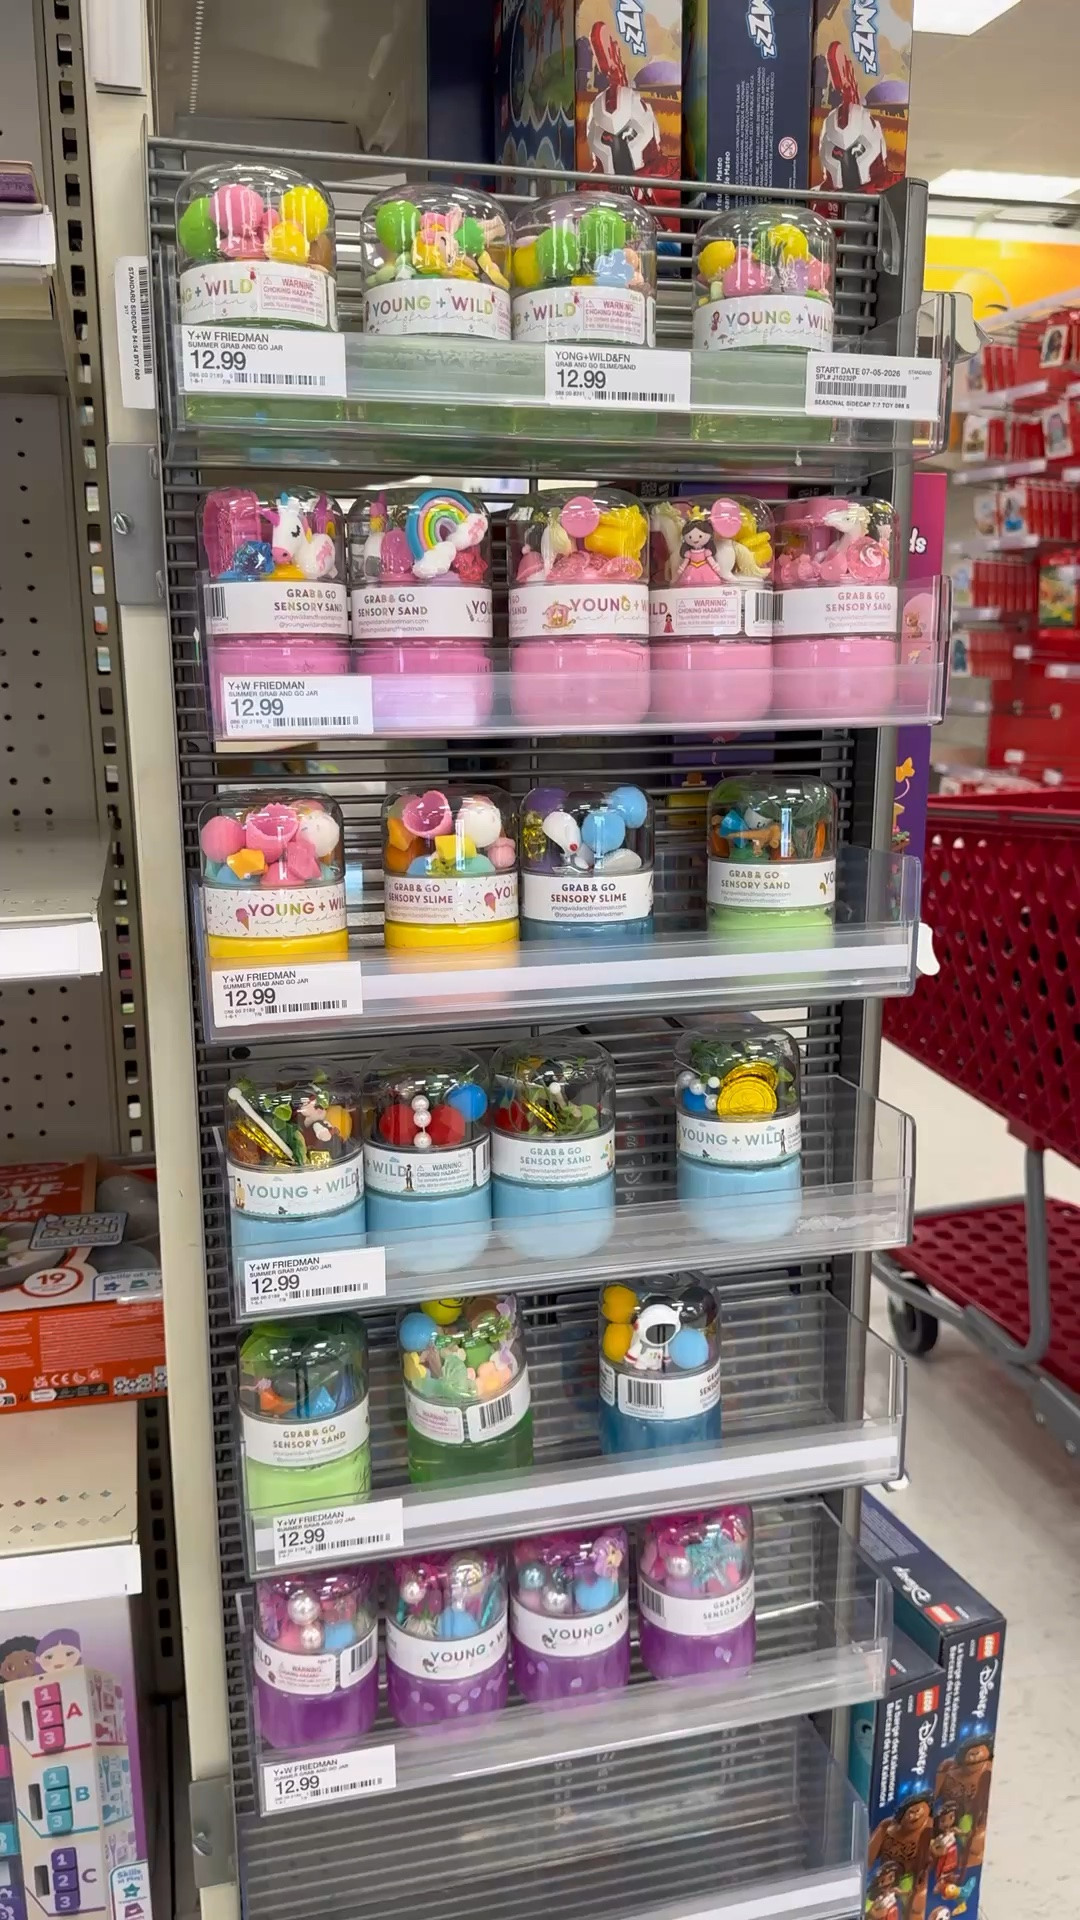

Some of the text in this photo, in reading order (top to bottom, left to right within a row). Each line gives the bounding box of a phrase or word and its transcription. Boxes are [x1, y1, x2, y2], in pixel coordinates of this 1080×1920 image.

[205, 278, 252, 296] WILD
[373, 296, 494, 316] YOUNG WILD
[533, 303, 576, 320] WILD
[726, 310, 791, 328] YOUNG
[188, 331, 268, 342] Y+W FRIEDMAN
[190, 350, 246, 370] 12.99
[556, 352, 630, 363] YONG+WILD&FN
[816, 366, 900, 377] START DATE 07-05-2026
[557, 370, 606, 388] 12.99
[846, 400, 870, 408] SIDECAP
[286, 588, 316, 598] GRAB
[325, 590, 336, 599] GO
[364, 594, 415, 604] GRAB GO
[838, 592, 885, 600] GRAB & GO
[274, 602, 342, 612] SENSORY SAND
[570, 597, 631, 612] YOUNG
[826, 603, 891, 612] SENSORY SAND
[358, 606, 428, 617] SENSORY SAND
[228, 682, 305, 690] Y+W FRIEDMAN
[231, 698, 284, 716] 12.99
[729, 870, 752, 878] GRAB
[764, 871, 780, 879] GO
[394, 883, 440, 892] GRAB & GO
[562, 883, 616, 892] GRAB & GO
[721, 880, 790, 890] SENSORY SAND
[389, 893, 453, 904] SENSORY SLIME
[550, 893, 626, 903] SENSORY SLIME
[248, 902, 314, 916] YOUNG
[223, 970, 296, 983] Y+W FRIEDMAN
[225, 988, 276, 1007] 12.99
[682, 1126, 728, 1145] YOUNG
[745, 1132, 780, 1146] WILD
[530, 1148, 556, 1156] GRAB
[558, 1148, 564, 1156] &
[520, 1156, 590, 1166] SENSORY SAND
[373, 1160, 406, 1178] WILD
[247, 1184, 308, 1199] YOUNG
[326, 1172, 357, 1192] WILD
[249, 1256, 320, 1272] Y+W FRIEDMAN
[37, 1273, 66, 1286] 19
[250, 1270, 276, 1278] SUMMER
[252, 1274, 300, 1294] 12.99
[283, 1430, 310, 1438] GRAB
[322, 1425, 336, 1434] GO
[273, 1431, 346, 1448] SENSORY SAND
[277, 1510, 344, 1527] Y+W FRIEDMAN
[280, 1528, 325, 1548] 12.99
[550, 1624, 604, 1640] YOUNG
[430, 1644, 486, 1664] YOUNG
[958, 1642, 964, 1653] La
[947, 1646, 956, 1680] Barcaza
[954, 1654, 963, 1679] barge
[40, 1688, 52, 1700] 1
[972, 1658, 998, 1718] Disney
[894, 1699, 902, 1710] La
[42, 1702, 82, 1723] 2 A
[884, 1702, 894, 1738] Barcaza
[892, 1711, 901, 1736] barge
[44, 1732, 55, 1744] 3
[884, 1738, 892, 1750] de
[911, 1713, 938, 1776] Disney
[891, 1738, 899, 1754] des
[882, 1751, 890, 1764] los
[274, 1759, 338, 1776] Y+W FRIEDMAN
[48, 1772, 60, 1784] 1
[276, 1776, 320, 1794] 12.99
[51, 1786, 90, 1806] 2 B
[52, 1816, 63, 1828] 3
[56, 1854, 68, 1866] 1
[58, 1868, 97, 1888] 2 C
[117, 1868, 142, 1878] Skills
[60, 1896, 70, 1908] 3
